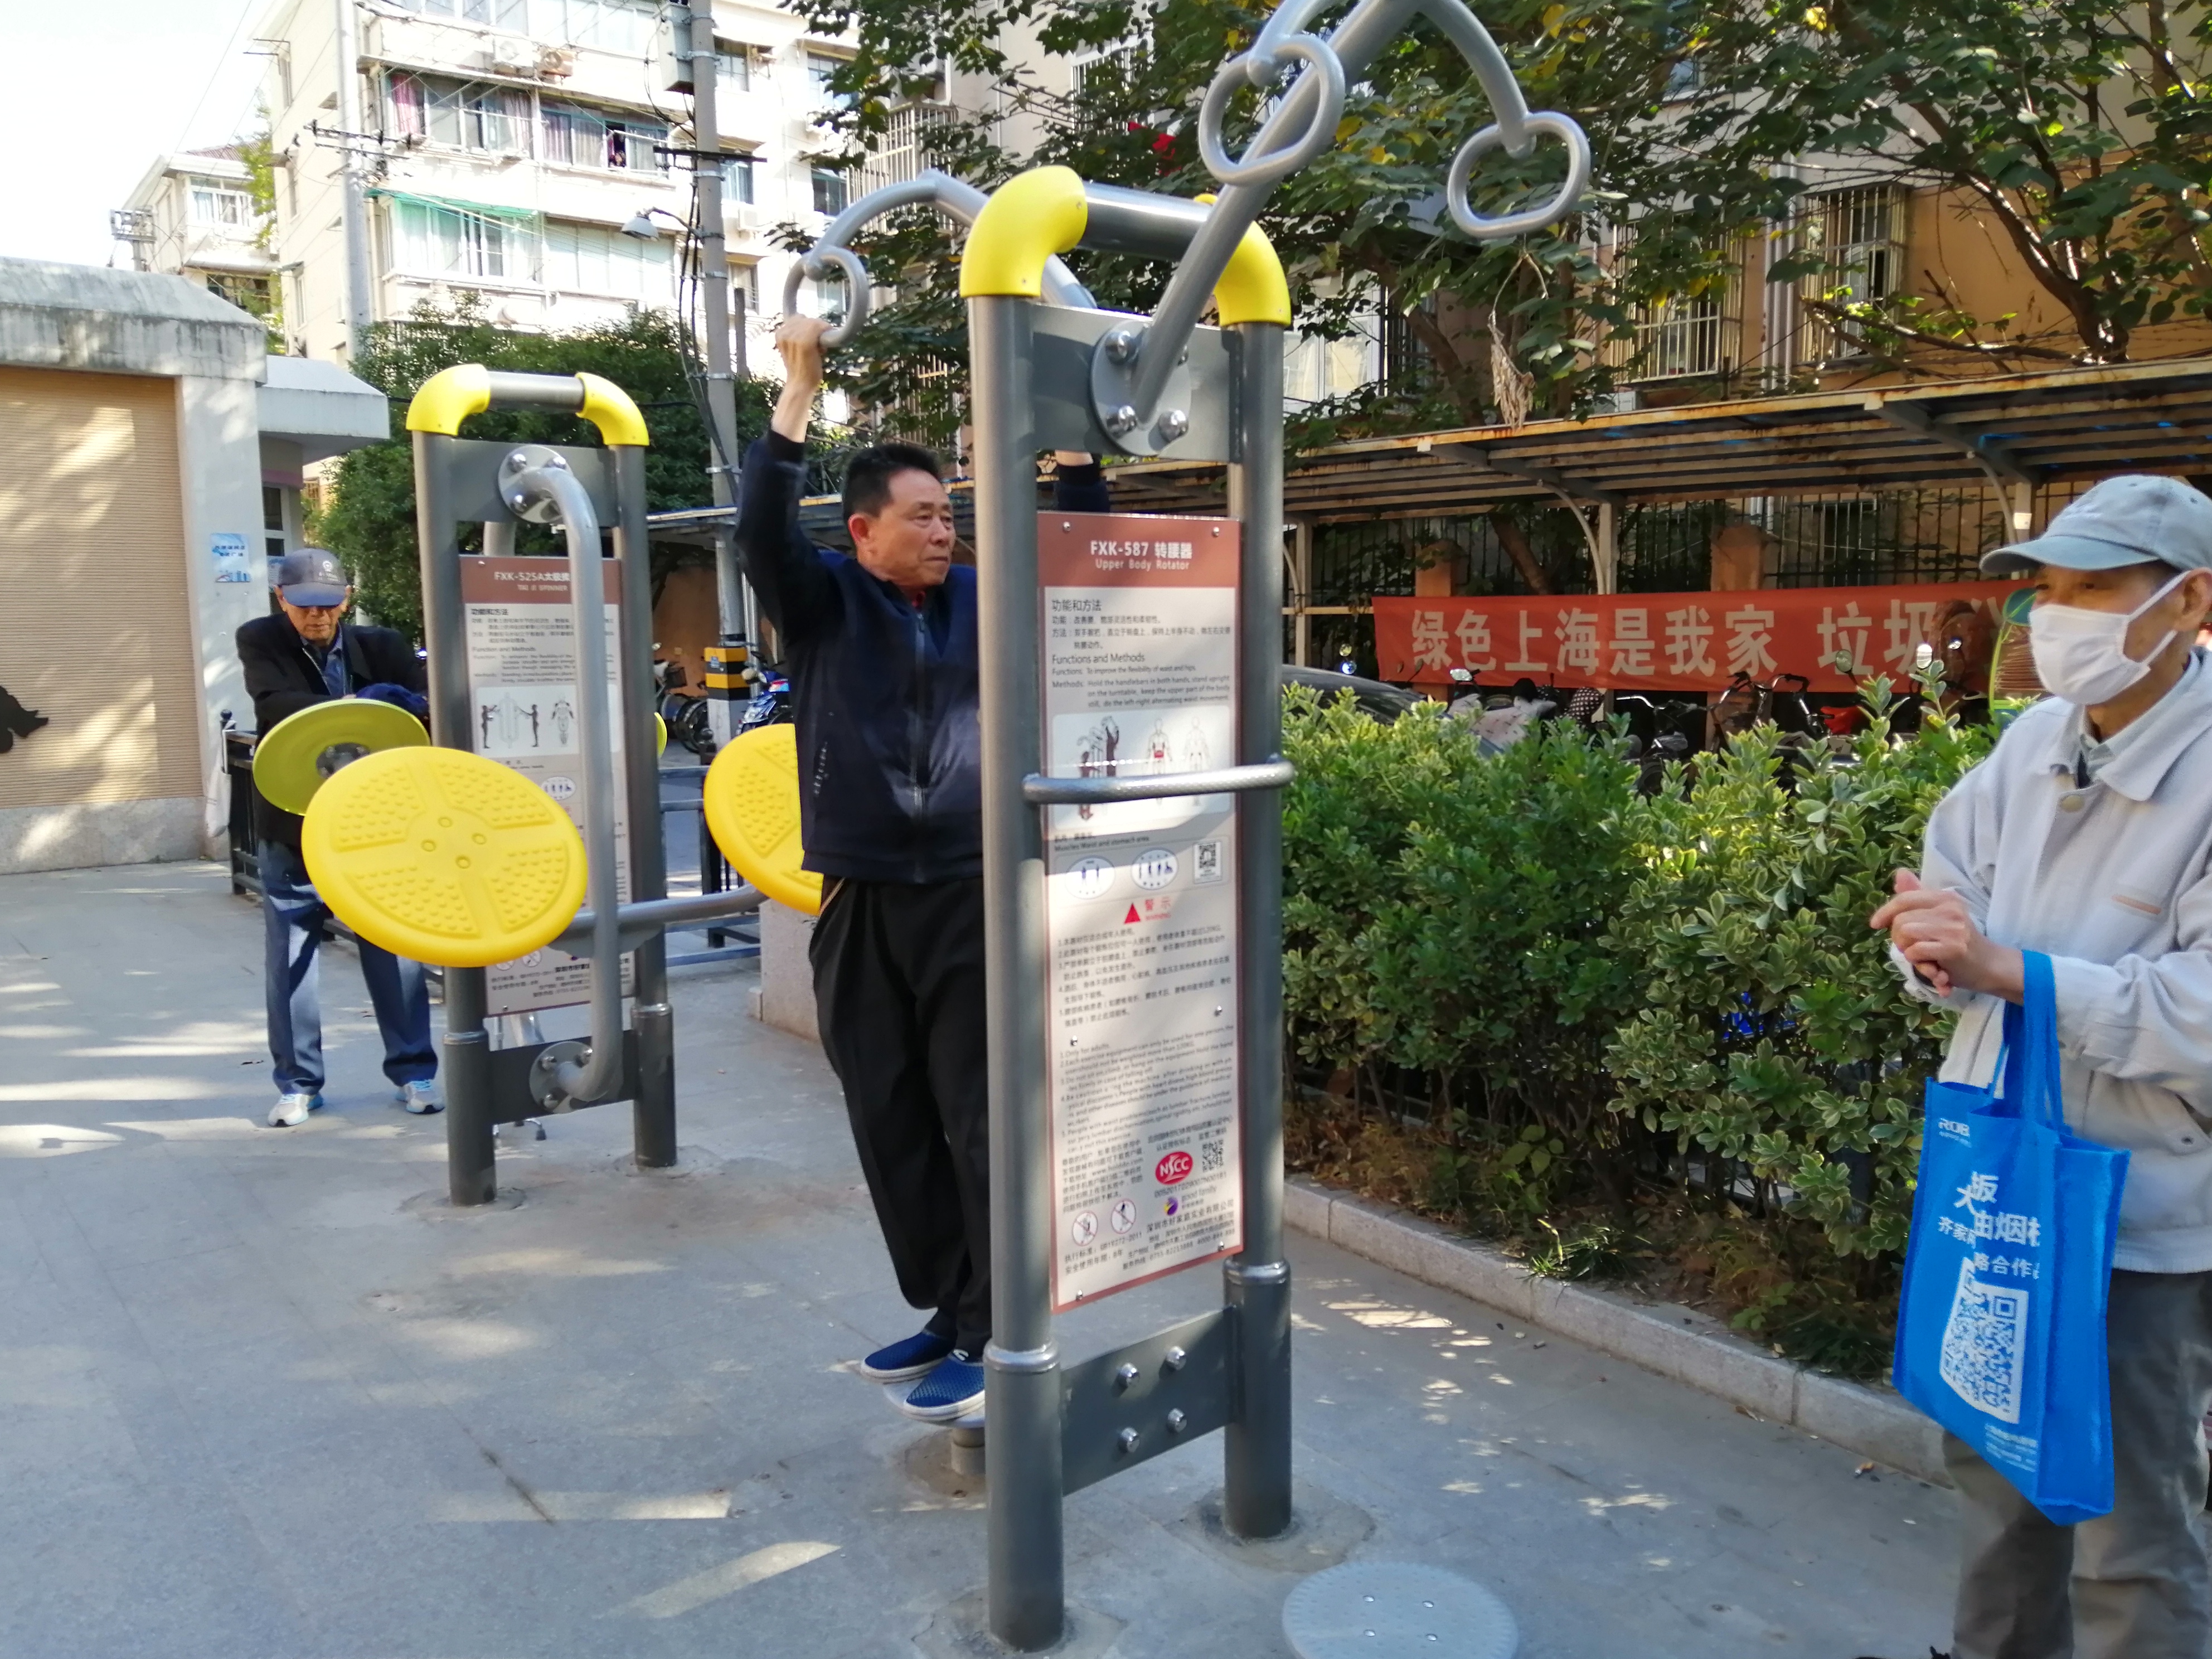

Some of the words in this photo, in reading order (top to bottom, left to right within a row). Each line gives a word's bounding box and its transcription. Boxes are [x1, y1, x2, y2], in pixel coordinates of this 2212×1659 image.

[1090, 540, 1149, 556] FXK-587
[1153, 541, 1192, 559] 转腰器
[1095, 559, 1124, 570] Upper
[1128, 559, 1151, 571] Body
[1156, 560, 1190, 570] Rotator
[1052, 599, 1102, 612] 功能和方法
[1412, 604, 1778, 677] 绿色上海是我家
[1052, 654, 1090, 664] Functions
[1093, 654, 1108, 663] and
[1110, 653, 1144, 663] Methods
